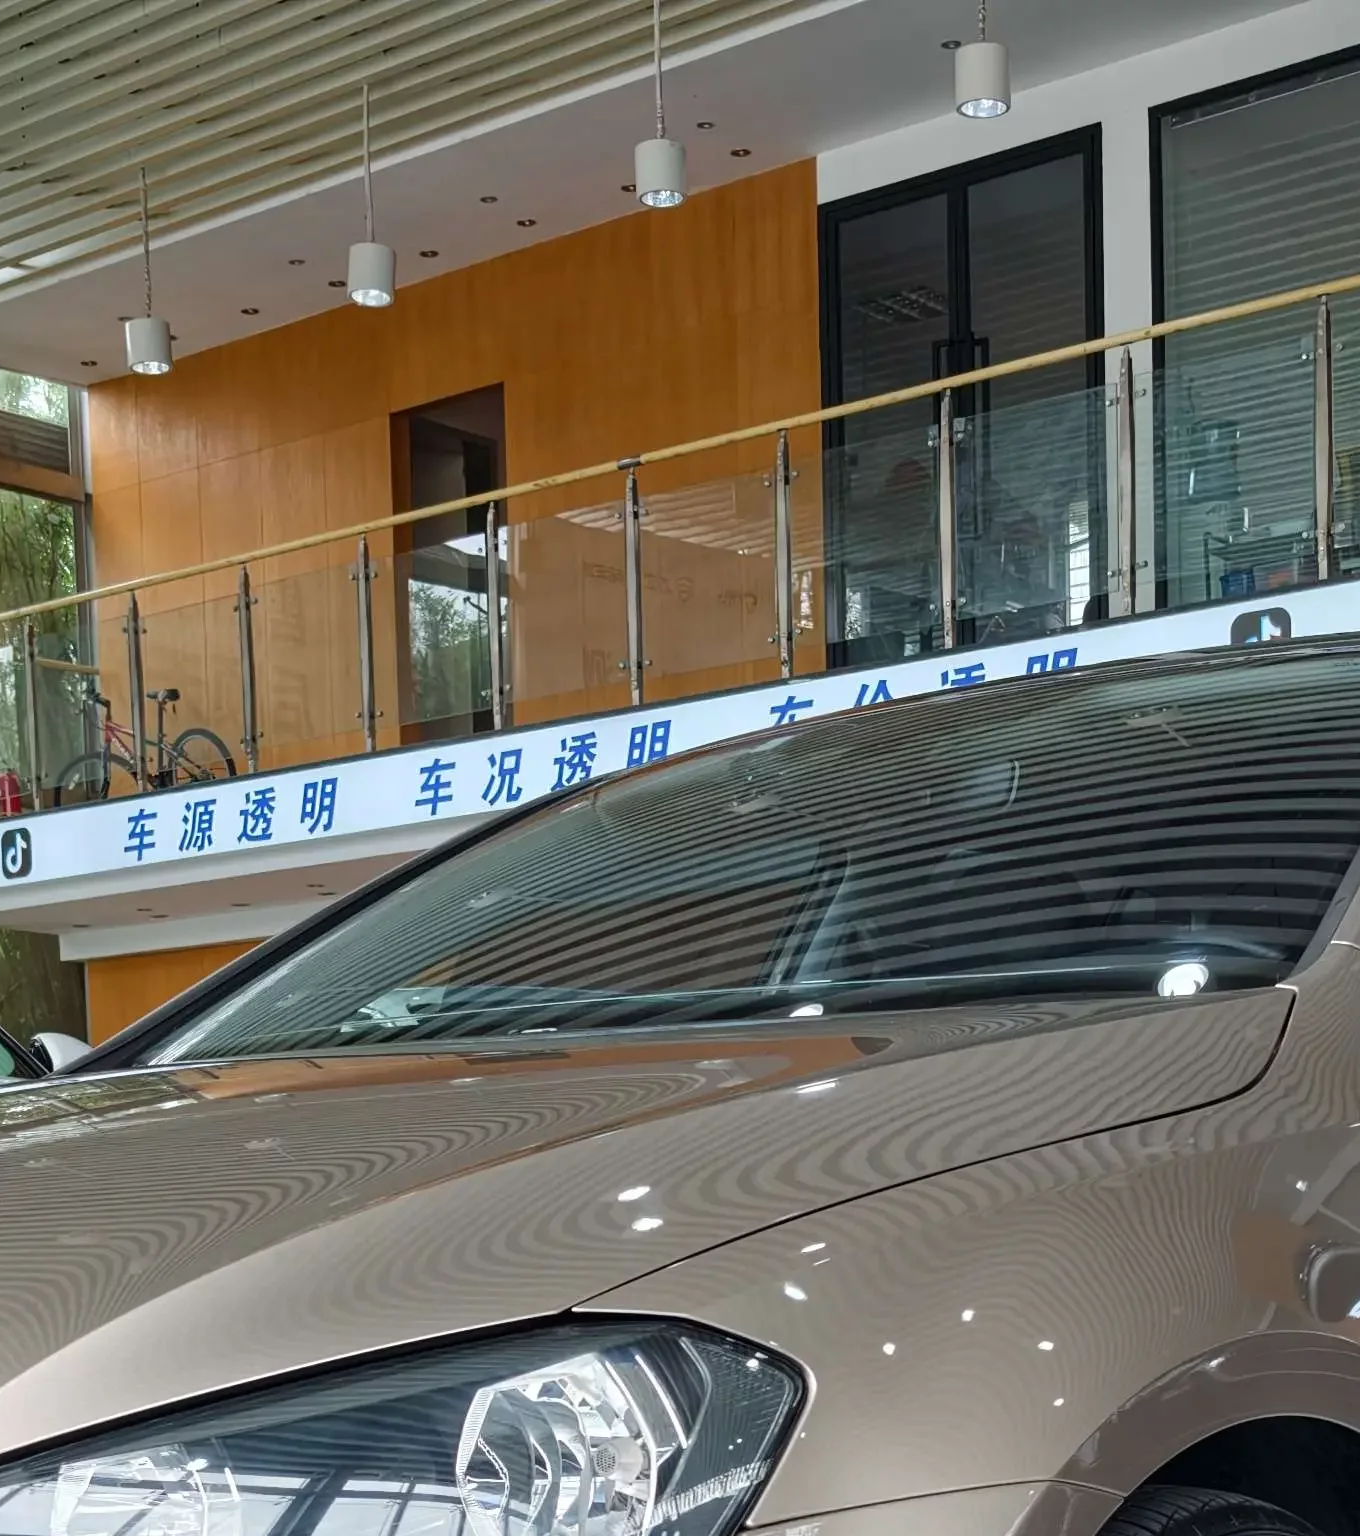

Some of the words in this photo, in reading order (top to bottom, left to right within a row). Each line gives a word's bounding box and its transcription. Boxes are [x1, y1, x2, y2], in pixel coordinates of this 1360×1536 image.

[415, 720, 672, 816] 车况透明
[124, 776, 339, 862] 车源透明
